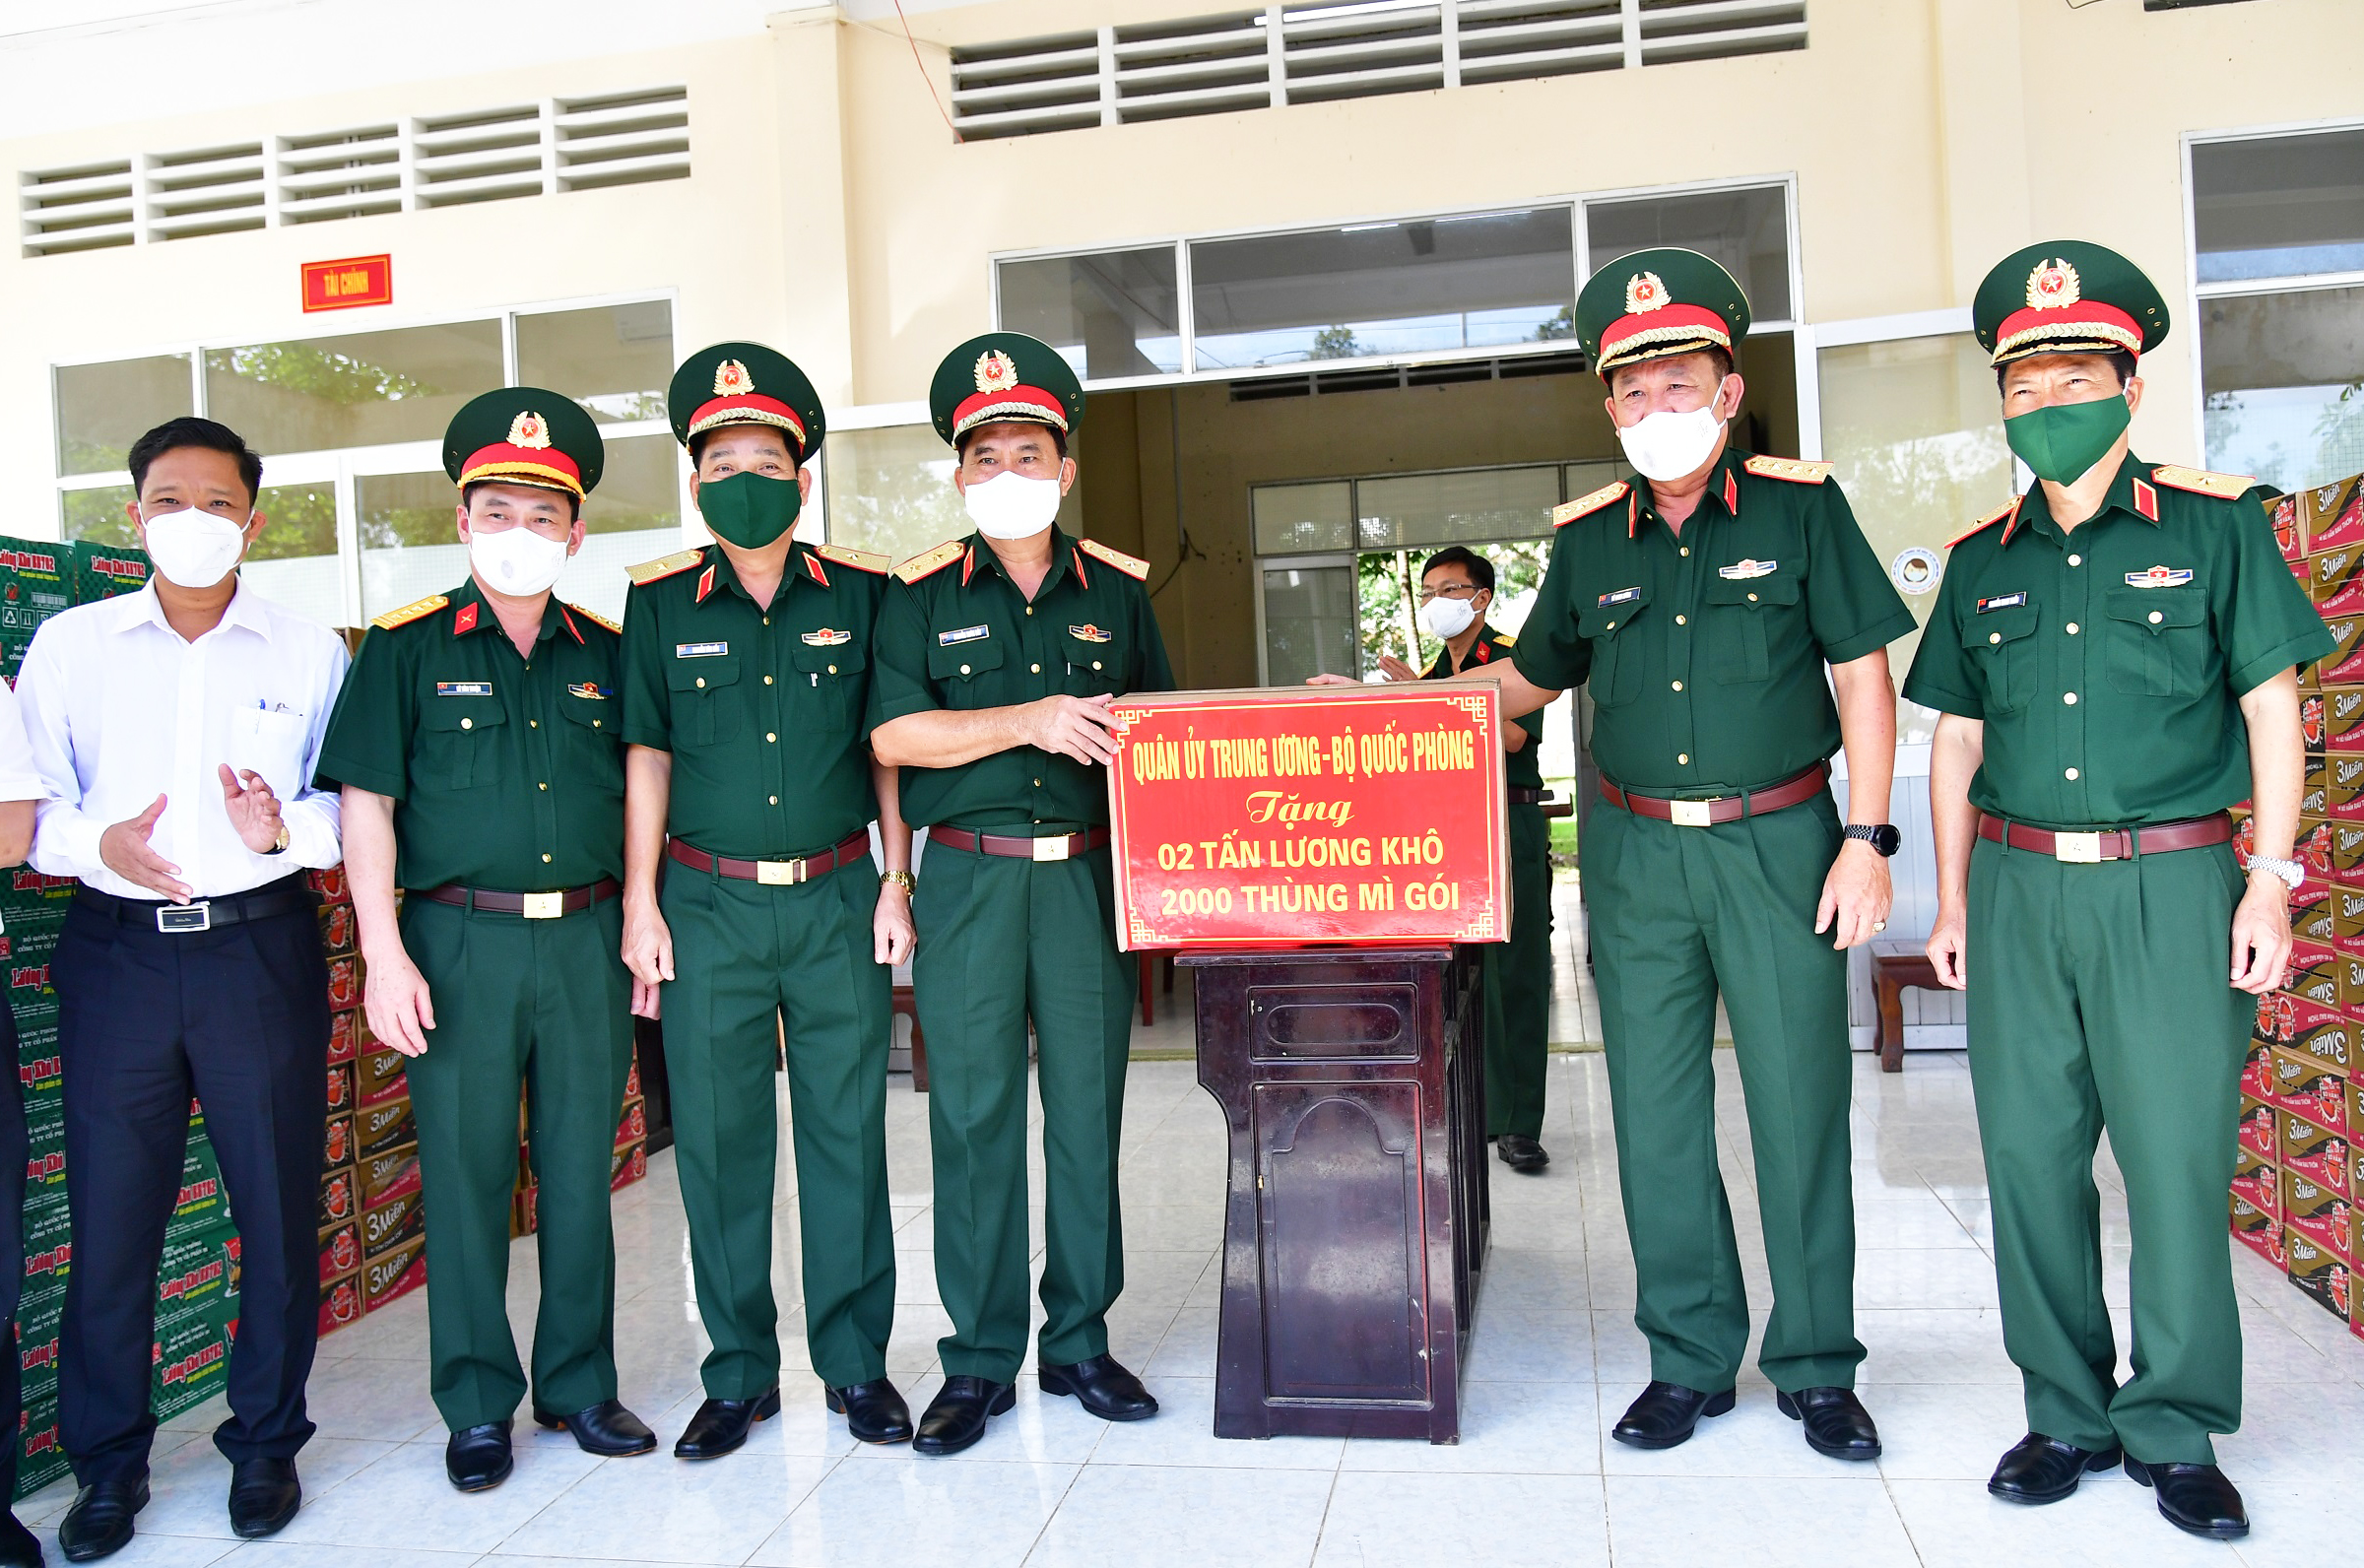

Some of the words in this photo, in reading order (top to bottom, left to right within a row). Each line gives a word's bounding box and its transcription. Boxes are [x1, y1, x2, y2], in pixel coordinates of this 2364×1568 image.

[1132, 733, 1181, 786] QUÂN
[1183, 725, 1206, 780] ỦY
[1210, 737, 1269, 779] TRUNG
[1360, 719, 1409, 778] QUỐC
[1412, 722, 1475, 772] PHÒNG
[1245, 790, 1355, 831] Tặng
[1157, 842, 1195, 872] 02
[1199, 828, 1261, 870] TẤN
[1270, 835, 1372, 868] LƯƠNG
[1381, 827, 1444, 866] KHÔ
[1162, 887, 1232, 915] 2000
[1240, 876, 1348, 913] THÙNG
[1358, 875, 1395, 911] MÌ
[1404, 872, 1460, 911] GÓI
